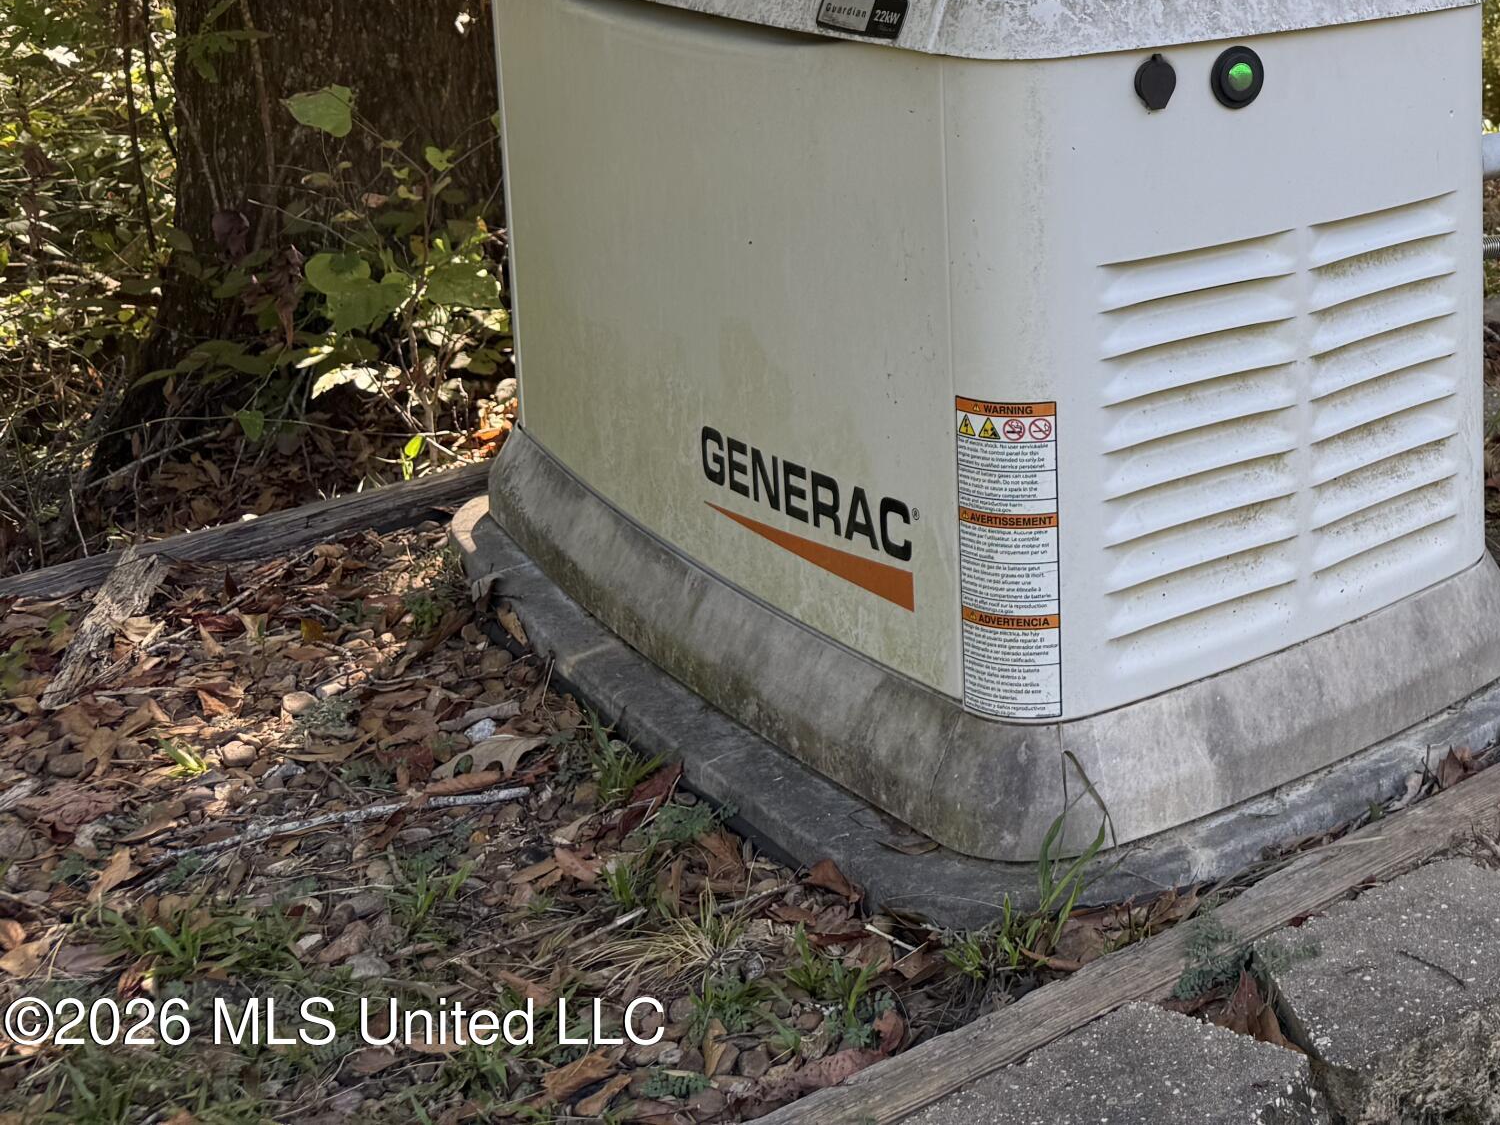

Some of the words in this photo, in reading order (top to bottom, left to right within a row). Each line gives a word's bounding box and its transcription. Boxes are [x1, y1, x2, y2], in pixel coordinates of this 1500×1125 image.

[825, 3, 867, 18] Guardian
[873, 9, 901, 25] 22kW
[983, 405, 1033, 415] WARNING
[970, 513, 1054, 526] AVERTISSEMENT
[978, 614, 1050, 627] ADVERTENCIA
